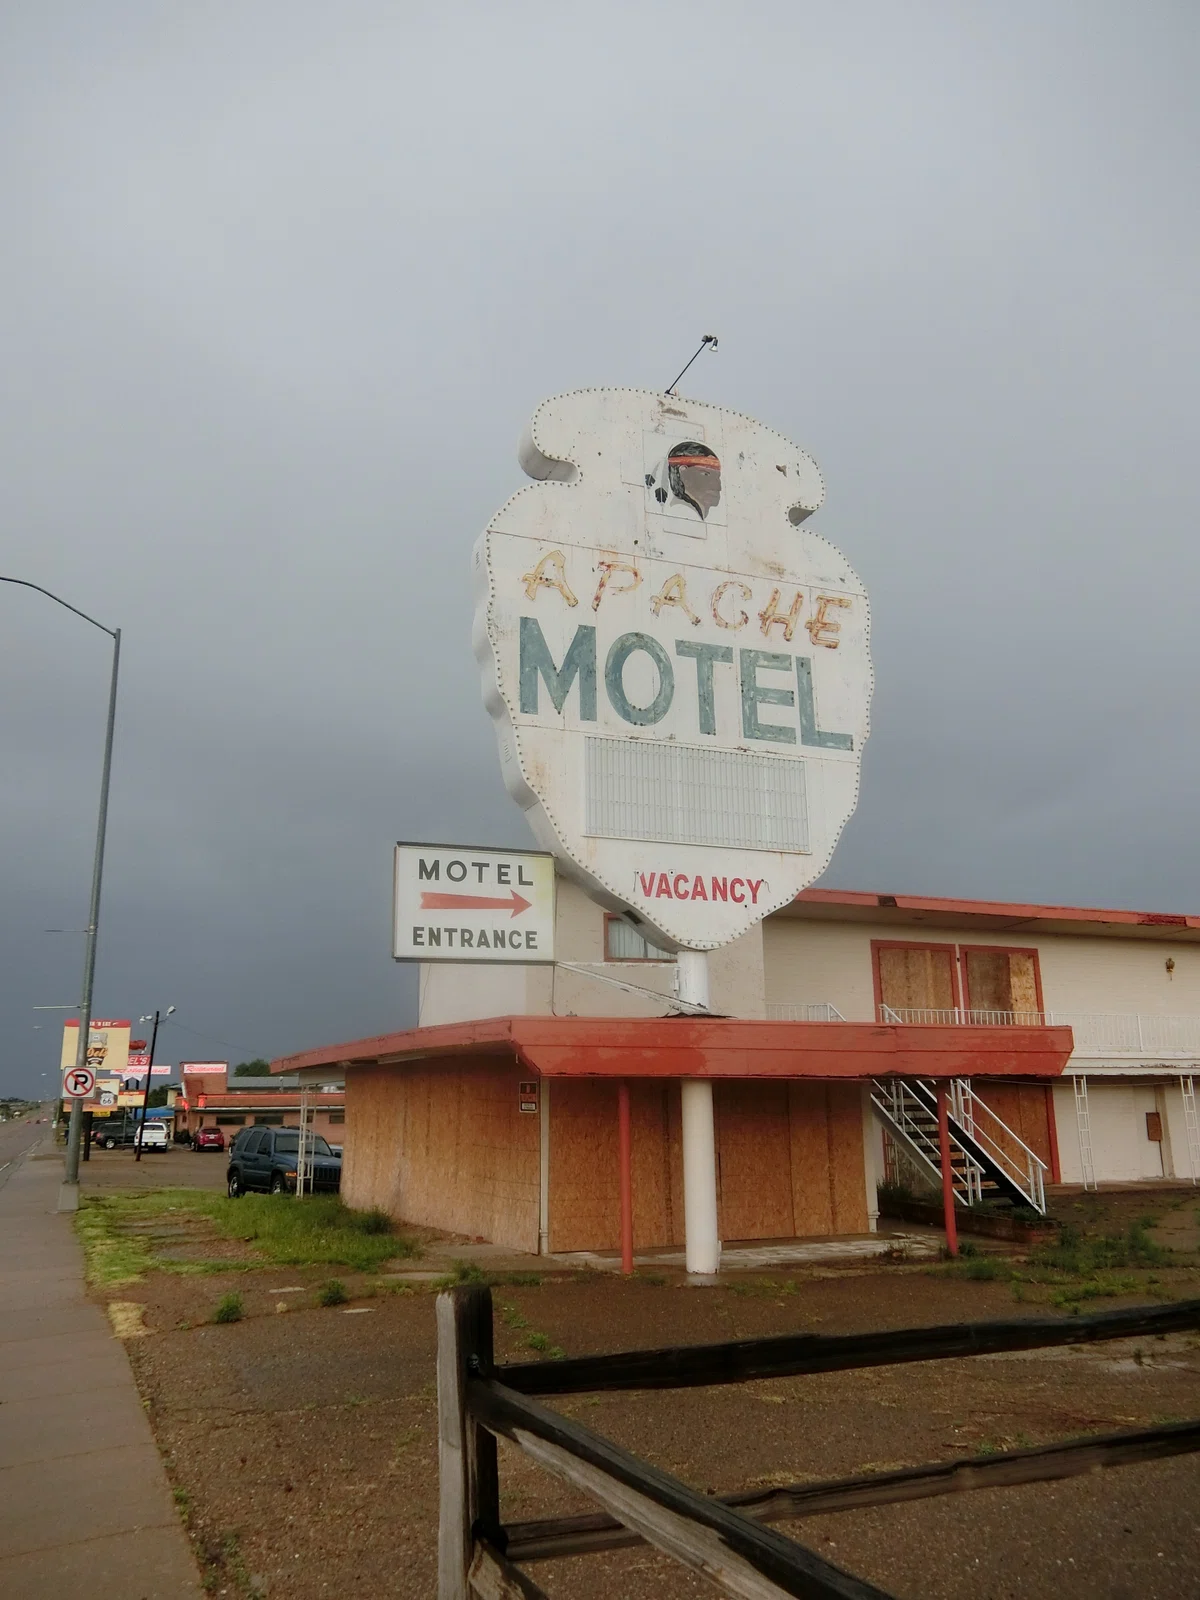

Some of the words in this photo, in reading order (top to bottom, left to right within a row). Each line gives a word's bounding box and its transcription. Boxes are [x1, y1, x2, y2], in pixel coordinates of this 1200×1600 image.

[522, 550, 852, 649] APACHE
[519, 616, 854, 752] MOTEL
[418, 858, 534, 887] MOTEL
[639, 871, 762, 905] VACANCY
[412, 926, 539, 950] ENTRANCE
[128, 1056, 148, 1065] EL'S
